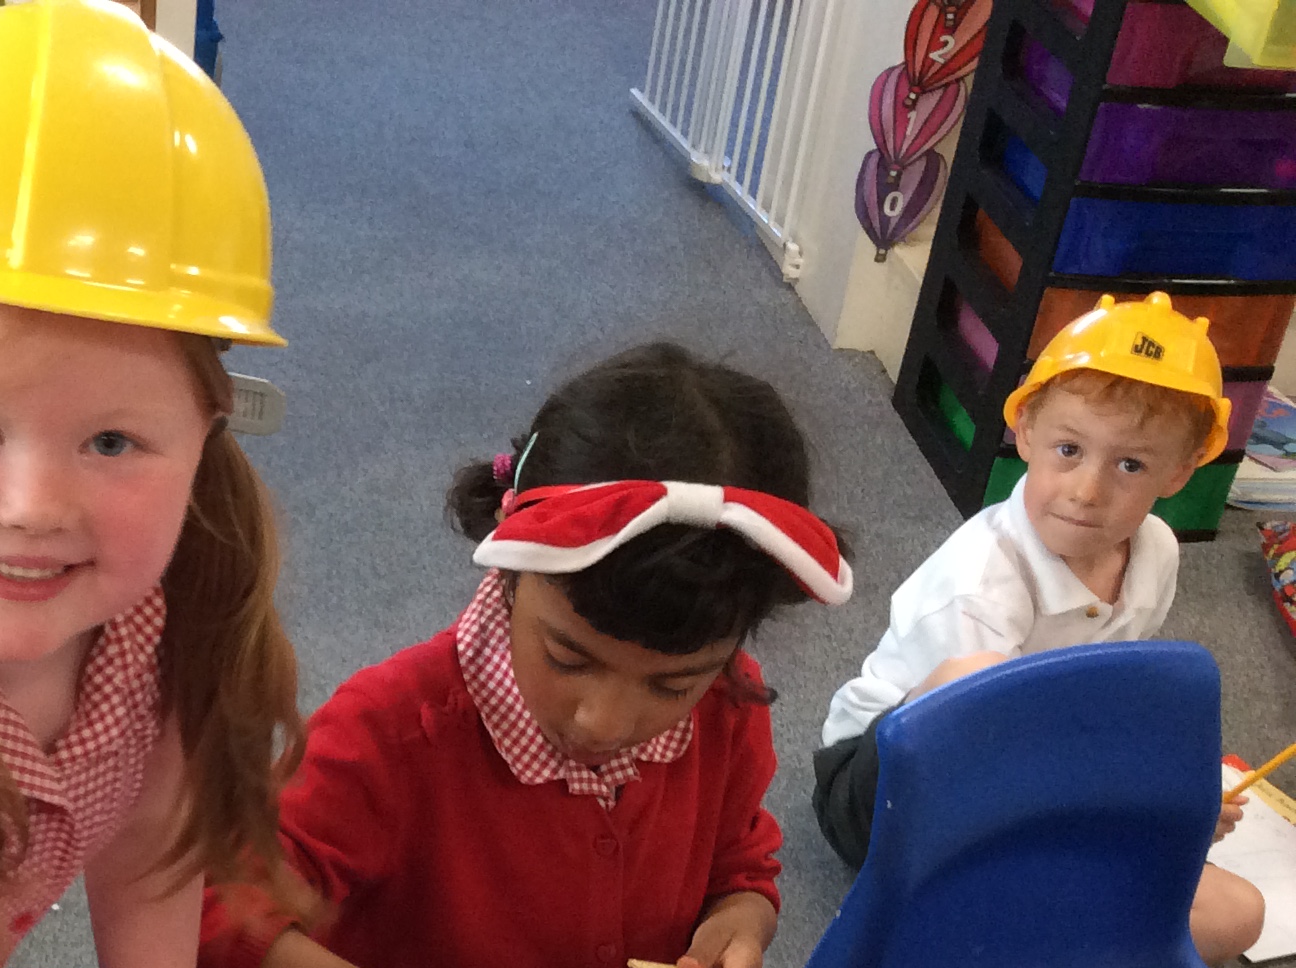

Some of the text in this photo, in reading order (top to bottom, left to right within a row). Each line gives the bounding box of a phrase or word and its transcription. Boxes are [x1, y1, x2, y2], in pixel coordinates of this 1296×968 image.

[929, 35, 954, 63] 2
[906, 110, 916, 135] 1
[883, 191, 904, 216] 0
[1134, 336, 1163, 359] JCB
